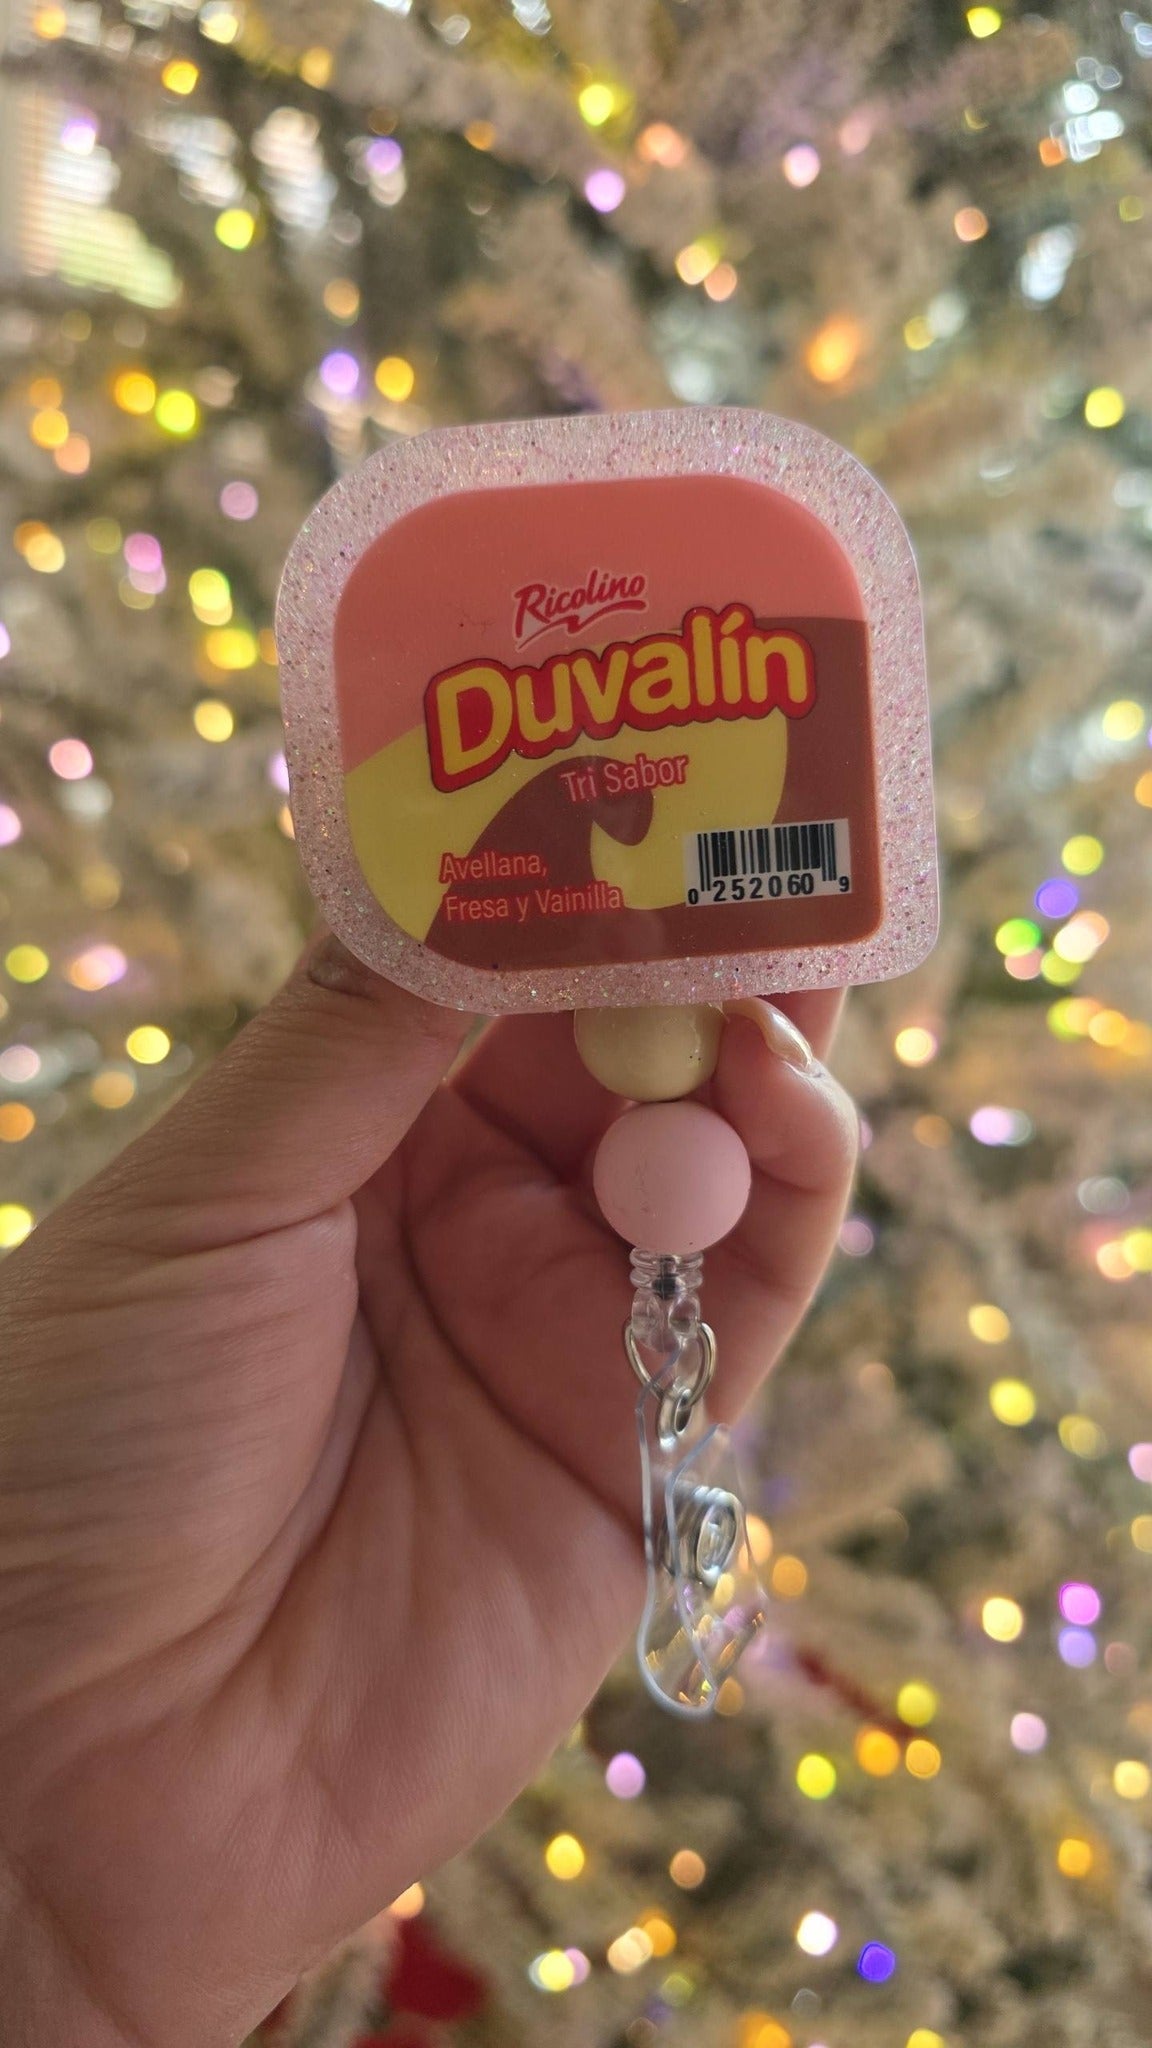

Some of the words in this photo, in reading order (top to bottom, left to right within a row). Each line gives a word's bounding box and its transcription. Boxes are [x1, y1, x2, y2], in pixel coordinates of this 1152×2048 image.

[513, 569, 647, 640] Ricolino
[436, 611, 808, 777] Duvalín
[560, 767, 598, 801] Tri
[603, 755, 688, 794] Sabor
[442, 851, 548, 881] Avellana,
[446, 894, 509, 921] Fresa
[516, 898, 529, 922] y
[535, 884, 622, 914] Vainilla
[687, 888, 699, 905] 0
[838, 875, 850, 892] 9
